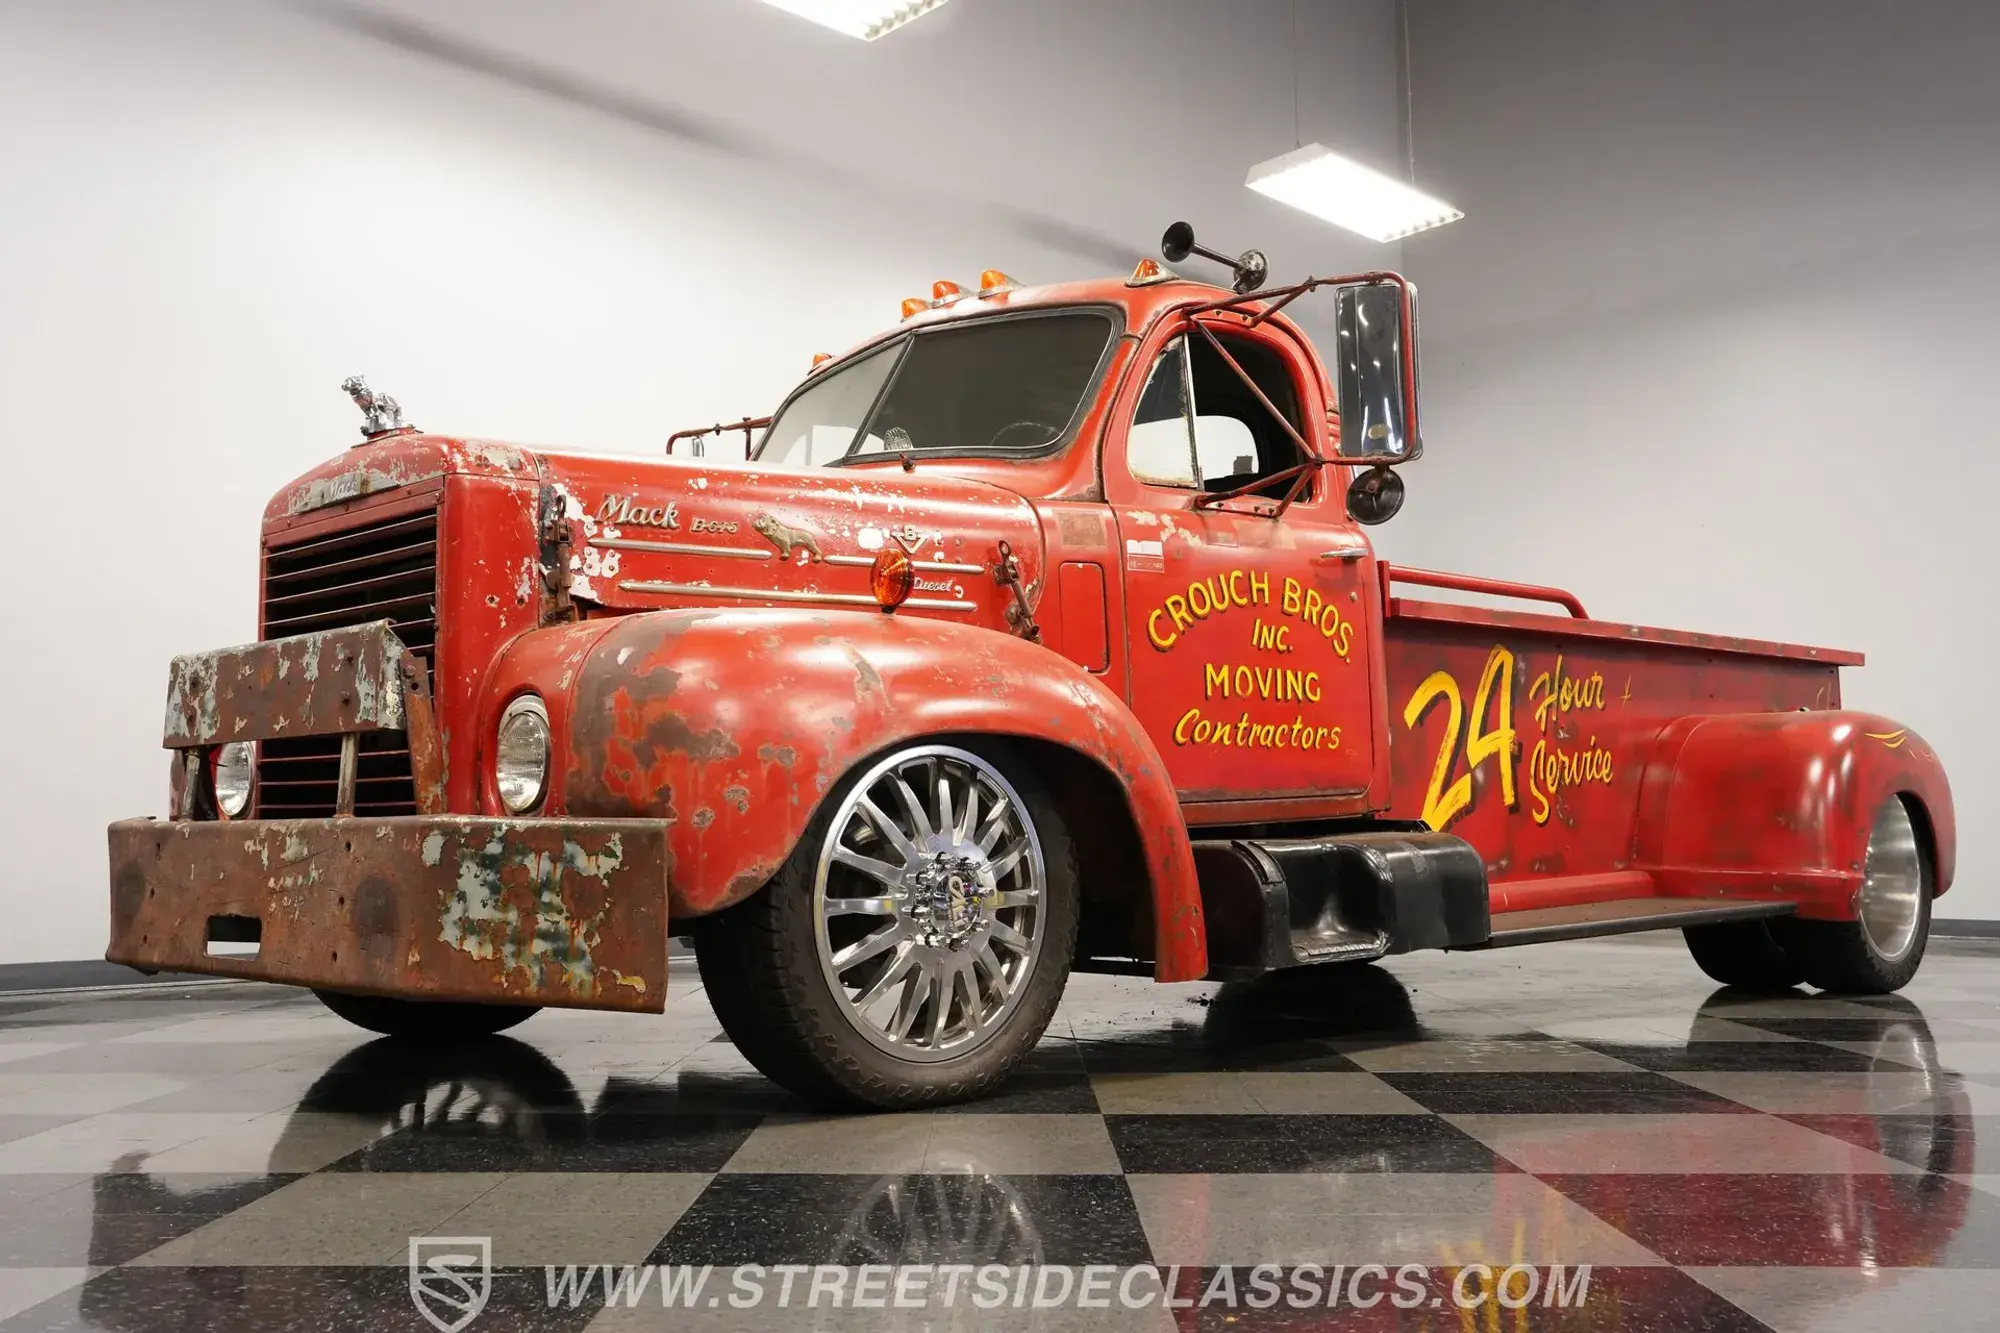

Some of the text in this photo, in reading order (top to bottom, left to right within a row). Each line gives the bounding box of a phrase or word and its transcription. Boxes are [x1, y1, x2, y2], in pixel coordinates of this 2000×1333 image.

[594, 493, 679, 529] Mack
[913, 577, 953, 592] Diesel
[1148, 569, 1270, 650] CROUCH
[1252, 618, 1294, 651] INC.
[1205, 663, 1322, 702] MOVING
[1173, 708, 1342, 749] Contractors
[1403, 643, 1606, 833] 24 Hour
[1529, 734, 1614, 825] Service
